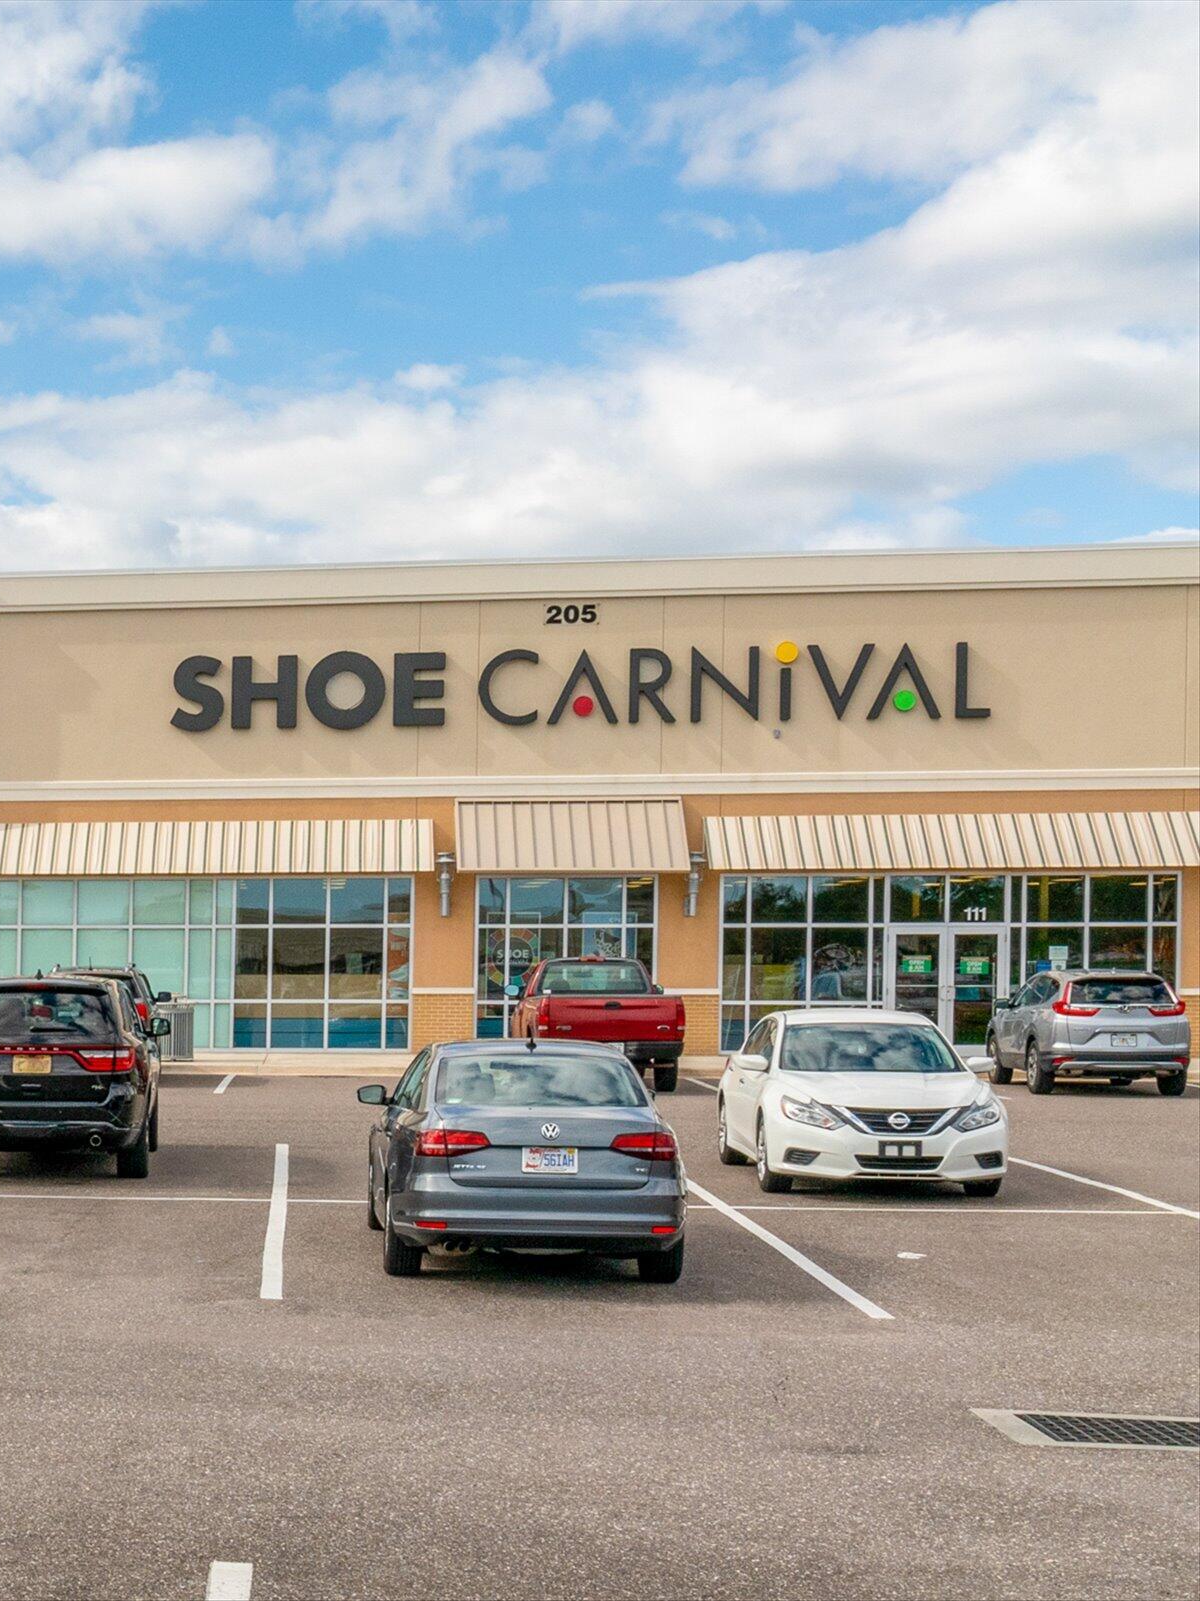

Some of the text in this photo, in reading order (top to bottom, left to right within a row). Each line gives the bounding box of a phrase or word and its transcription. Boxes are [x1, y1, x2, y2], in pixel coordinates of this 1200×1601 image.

[545, 604, 597, 624] 205
[170, 650, 447, 733] SHOE
[963, 906, 987, 921] 111
